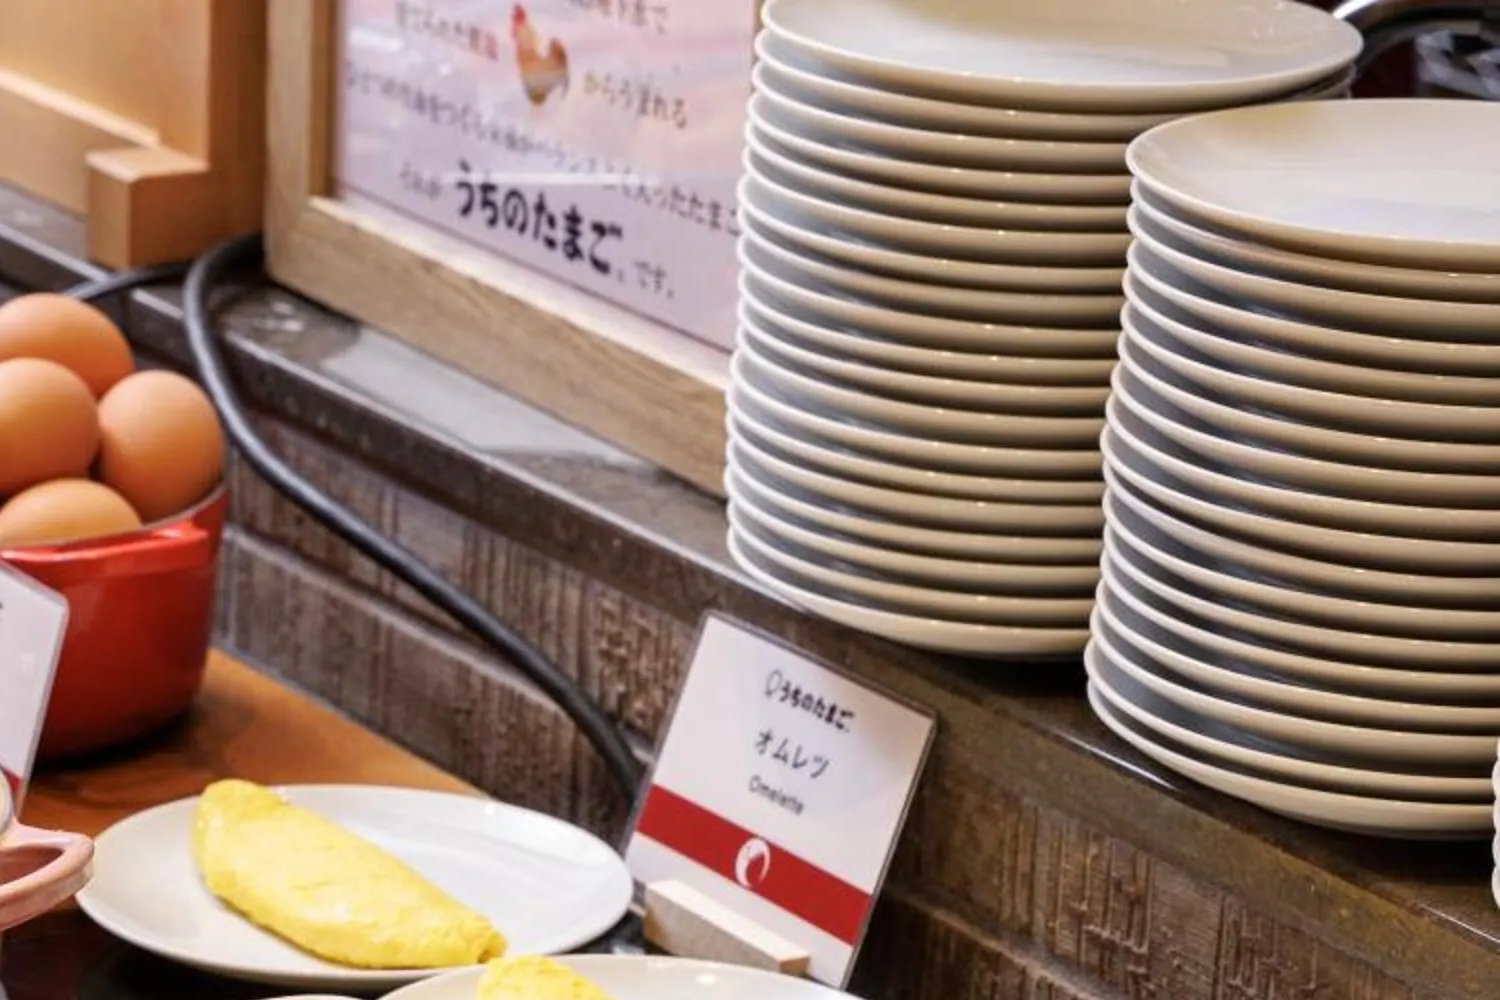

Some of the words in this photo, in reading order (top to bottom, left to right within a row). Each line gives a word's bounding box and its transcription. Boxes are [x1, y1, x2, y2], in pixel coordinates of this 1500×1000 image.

[456, 160, 623, 274] うちのたまご
[754, 729, 831, 779] オムレツ
